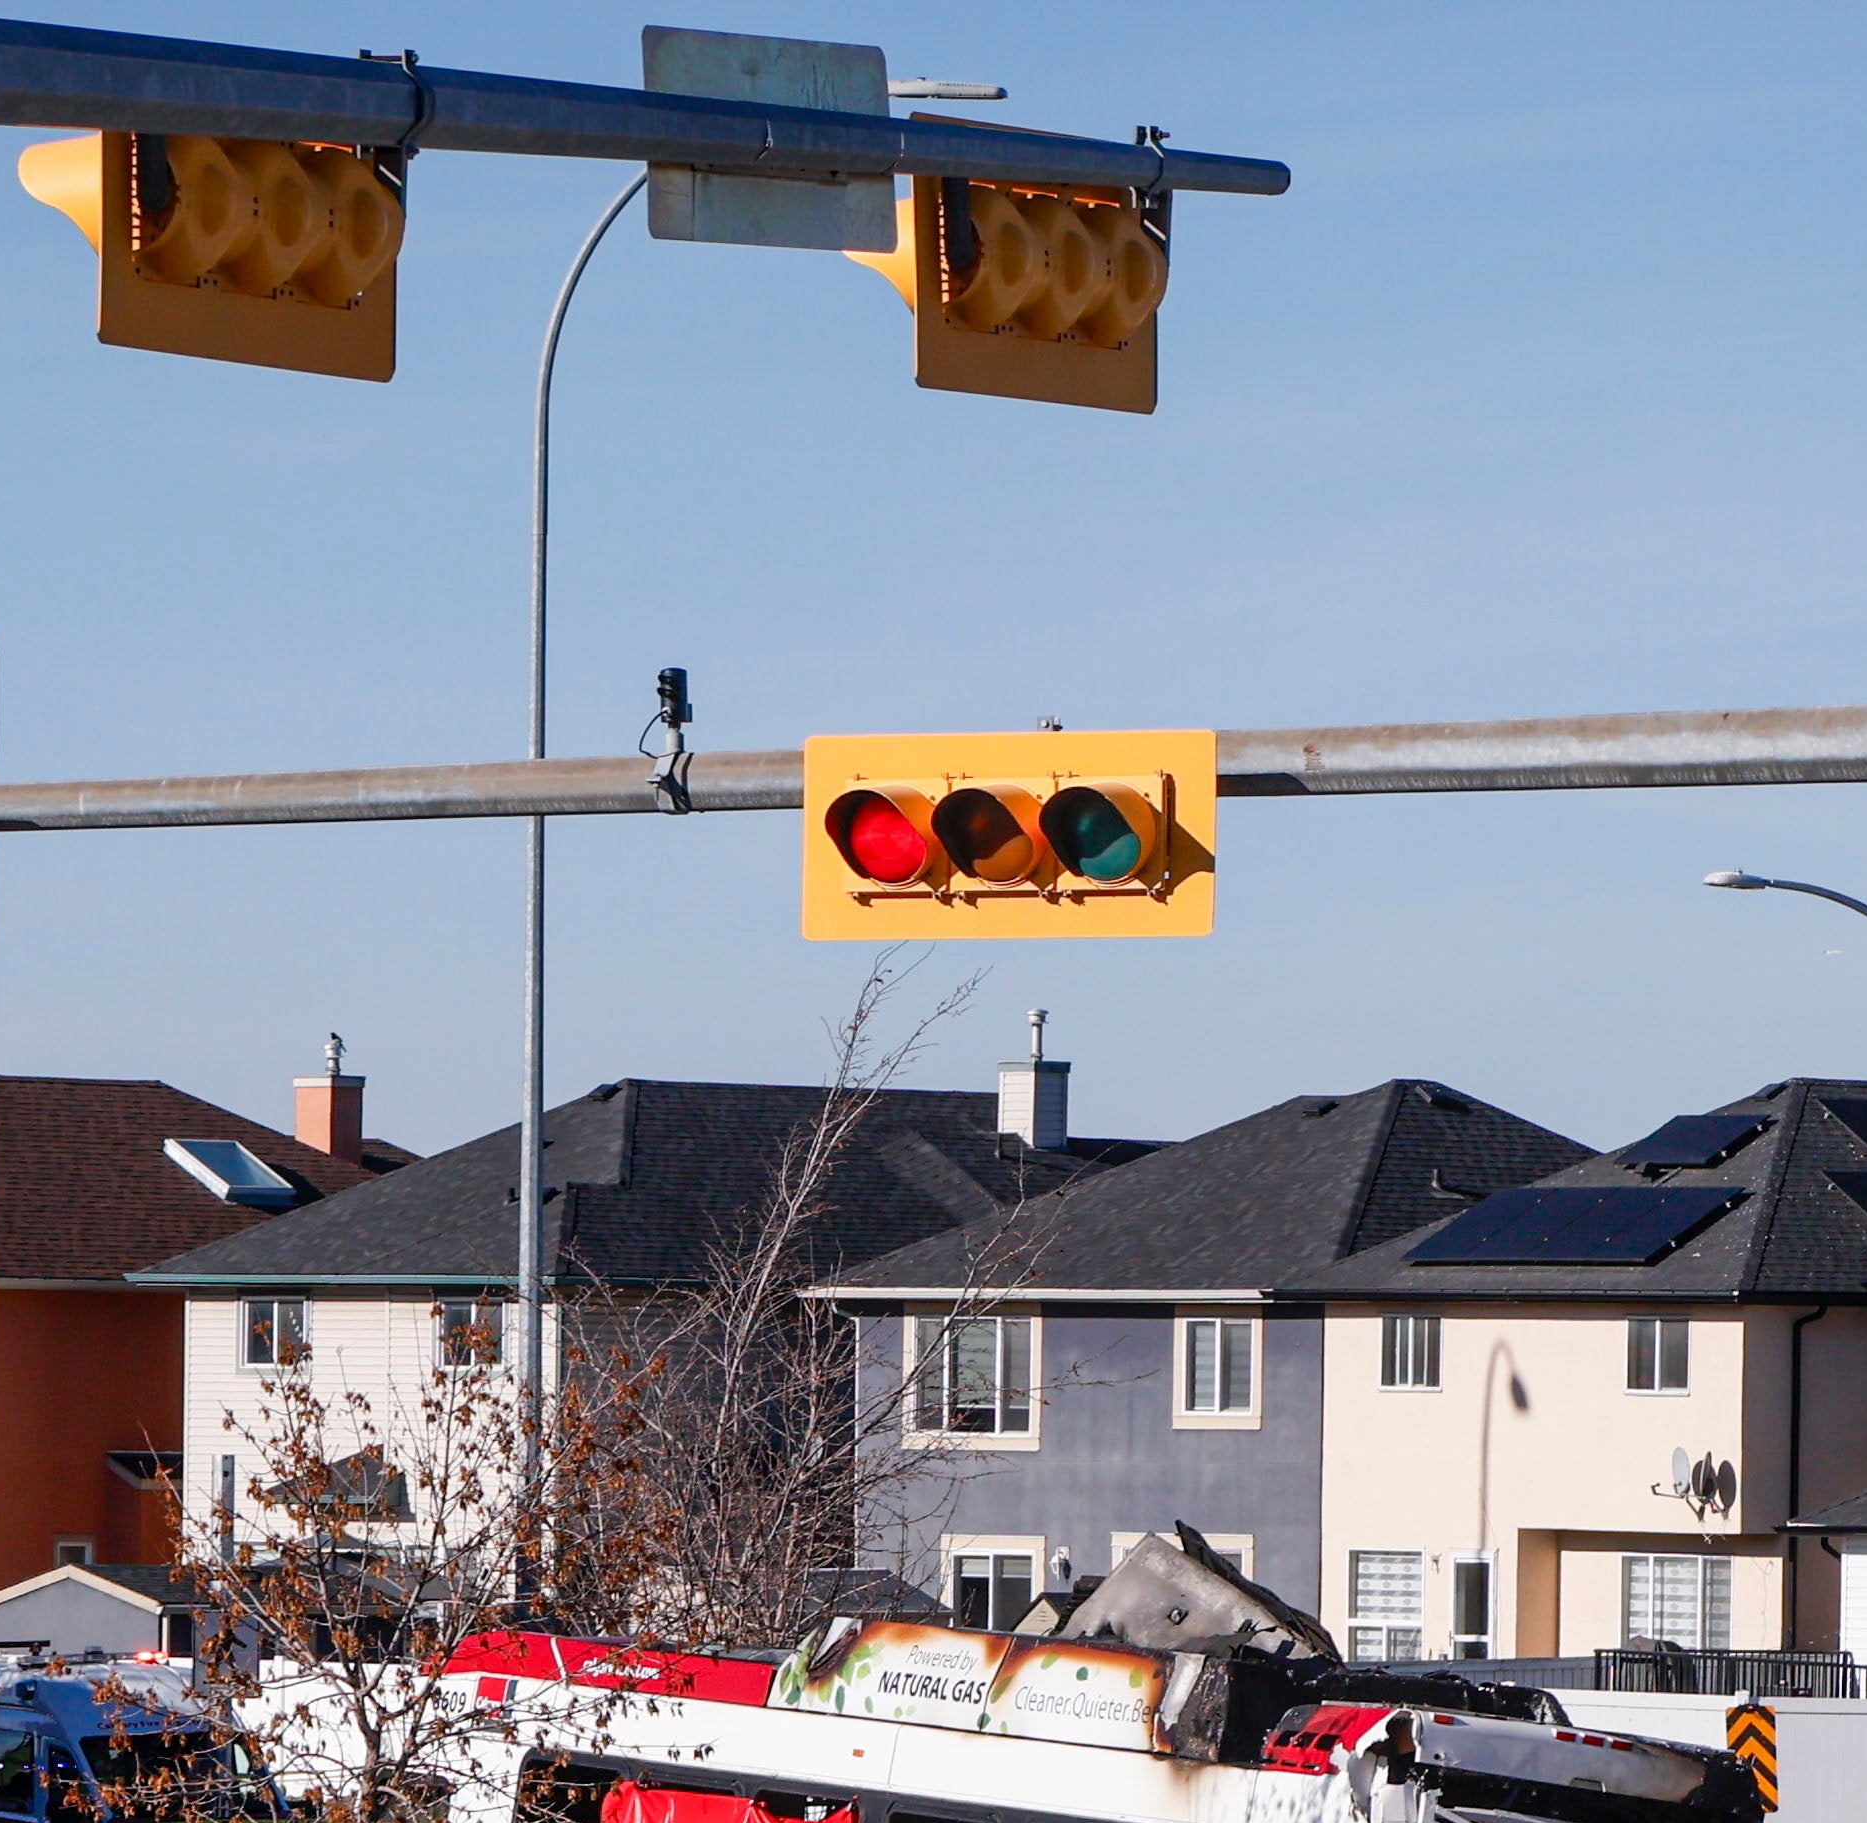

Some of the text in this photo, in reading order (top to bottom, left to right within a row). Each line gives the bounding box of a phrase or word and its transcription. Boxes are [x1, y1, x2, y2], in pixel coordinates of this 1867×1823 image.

[906, 1644, 978, 1675] Powered by
[878, 1670, 986, 1705] NATURAL GAS
